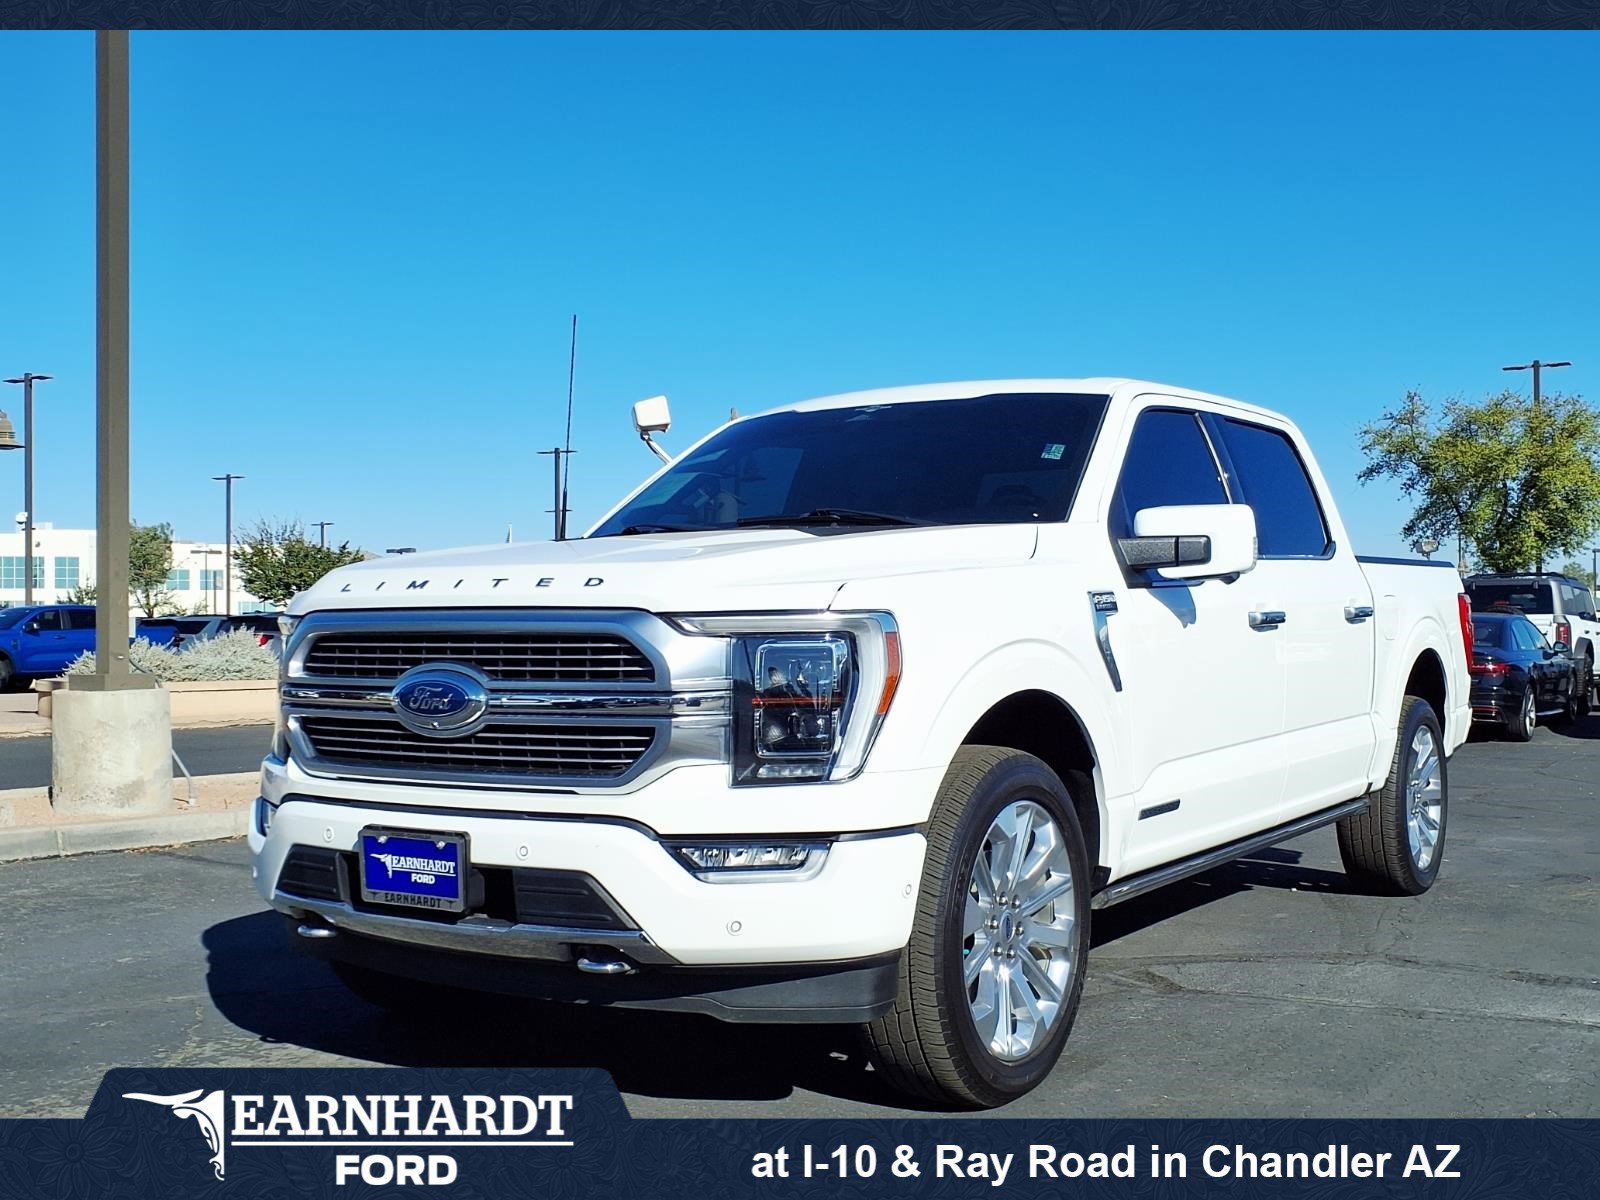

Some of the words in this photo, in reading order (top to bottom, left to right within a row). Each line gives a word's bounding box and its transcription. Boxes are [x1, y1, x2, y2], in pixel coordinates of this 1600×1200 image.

[341, 577, 605, 592] LIMITED
[409, 685, 453, 711] Ford
[391, 855, 456, 874] EARNHARDT
[411, 873, 436, 885] FORD
[384, 891, 442, 909] EARNHARDT
